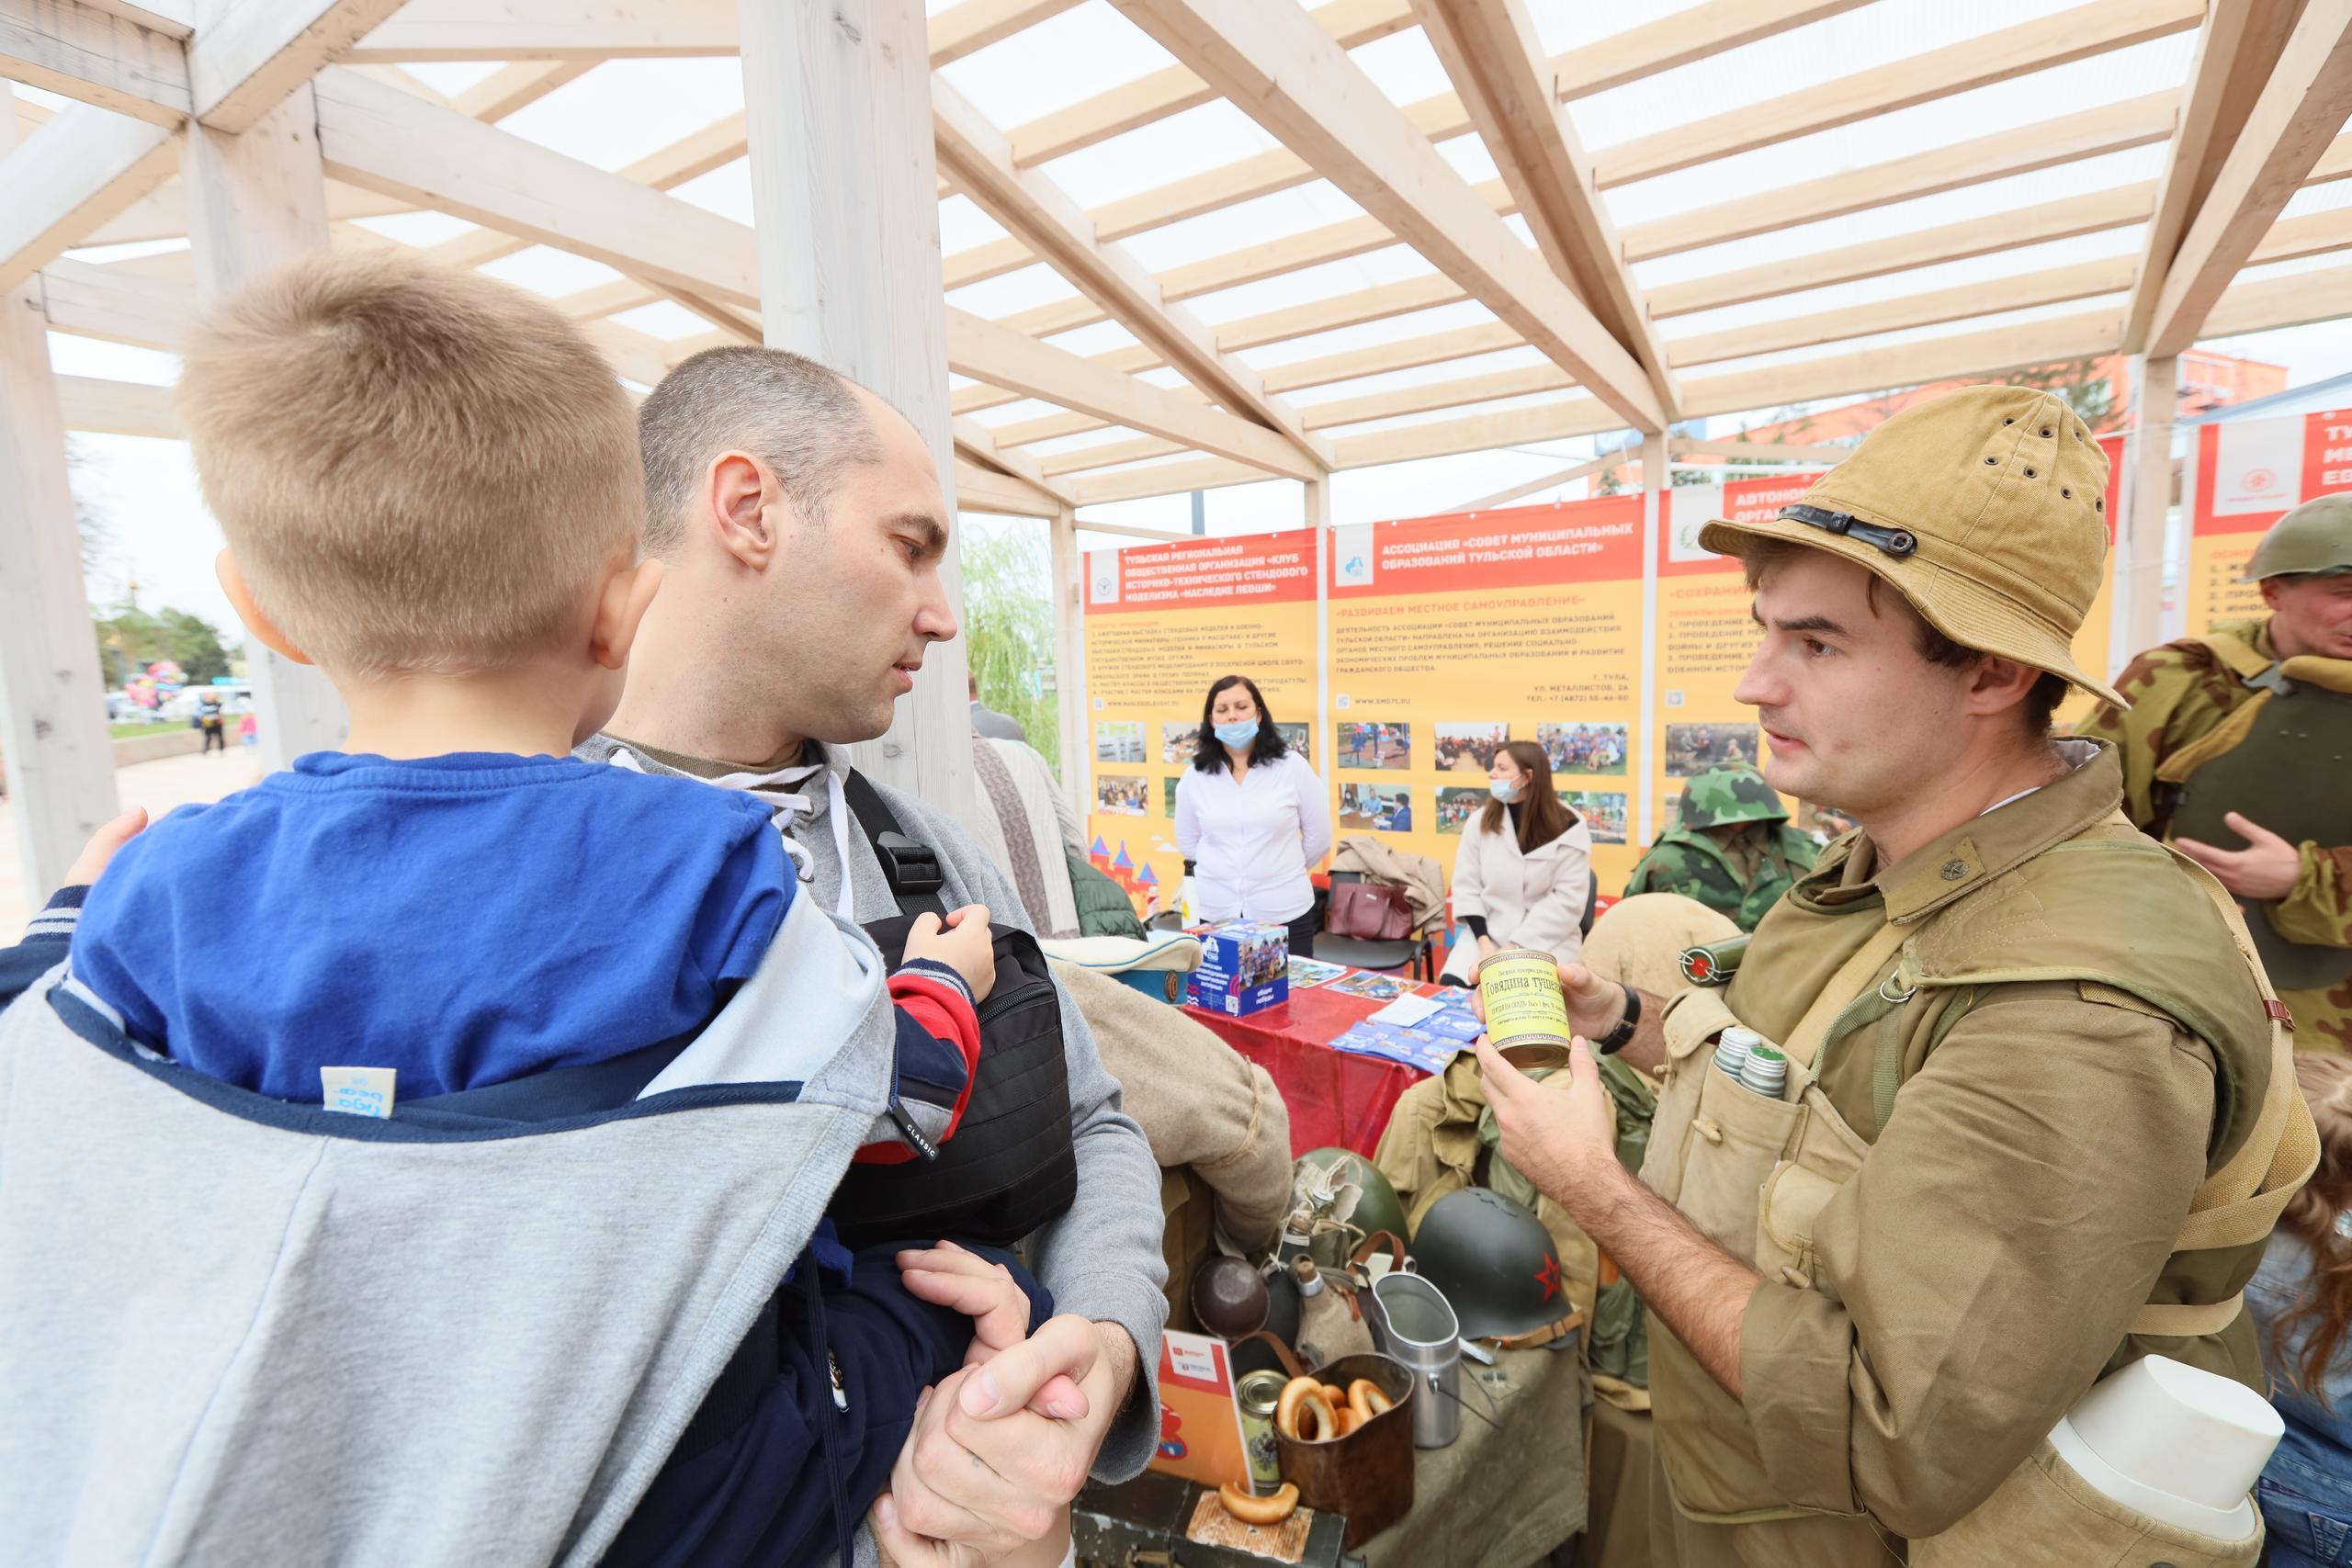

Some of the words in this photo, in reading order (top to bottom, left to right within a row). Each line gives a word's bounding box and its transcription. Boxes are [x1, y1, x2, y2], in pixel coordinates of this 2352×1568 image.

[1382, 538, 1460, 556] АССОЦИАЦИЯ
[1462, 534, 1509, 548] «СОВЕТ
[1510, 522, 1634, 544] МУНИЦИПАЛЬНЫХ
[1125, 553, 1170, 566] ТУЛЬСКАЯ
[1171, 546, 1243, 562] РЕГИОНАЛЬНАЯ
[1125, 563, 1196, 578] ОБЩЕСТВЕННАЯ
[1198, 557, 1265, 571] ОРГАНИЗАЦИЯ
[1267, 553, 1299, 565] «КЛУБ
[1382, 551, 1465, 570] ОБРАЗОВАНИЙ
[1468, 546, 1532, 564] ТУЛЬСКОЙ
[1536, 542, 1604, 558] ОБЛАСТИ»
[1125, 571, 1242, 590] ИСТОРИКО-ТЕХНИЧЕСКОГО
[1244, 566, 1308, 581] СТЕНДОВОГО
[1125, 590, 1179, 603] МОДЕЛИЗМА
[1181, 585, 1234, 598] «НАСЛЕДИЕ
[1236, 582, 1277, 595] ЛЕВШИ»
[1336, 606, 1405, 617] «РАЗВИВАЕМ
[1408, 603, 1460, 615] МЕСТНОЕ
[1464, 595, 1586, 612] САМОУПРАВЛЕНИЕ»
[1336, 626, 1391, 635] ДЕЯТЕЛЬНОСТЬ
[1393, 623, 1443, 631] АССОЦИАЦИИ
[1476, 618, 1549, 627] МУНИЦИПАЛЬНЫХ
[1552, 615, 1615, 624] ОБРАЗОВАНИЙ
[1336, 637, 1373, 645] ТУЛЬСКОЙ
[1412, 632, 1464, 641] НАПРАВЛЕНА
[1477, 629, 1537, 638] ОРГАНИЗАЦИЮ
[1540, 626, 1623, 636] ВЗАИМОДЕЙСТВИЯ
[1336, 656, 1396, 664] ЭКОНОМИЧЕСКИХ
[1398, 654, 1433, 662] ПРОБЛЕМ
[1436, 652, 1506, 661] МУНИЦИПАЛЬНЫХ
[1580, 648, 1625, 656] РАЗВИТИЕ
[1369, 645, 1407, 653] МЕСТНОГО
[1484, 640, 1522, 649] РЕШЕНИЕ
[1336, 666, 1392, 674] ГРАЖДАНСКОГО
[1486, 976, 1530, 998] Говядина
[907, 1123, 935, 1157] CLASSIC
